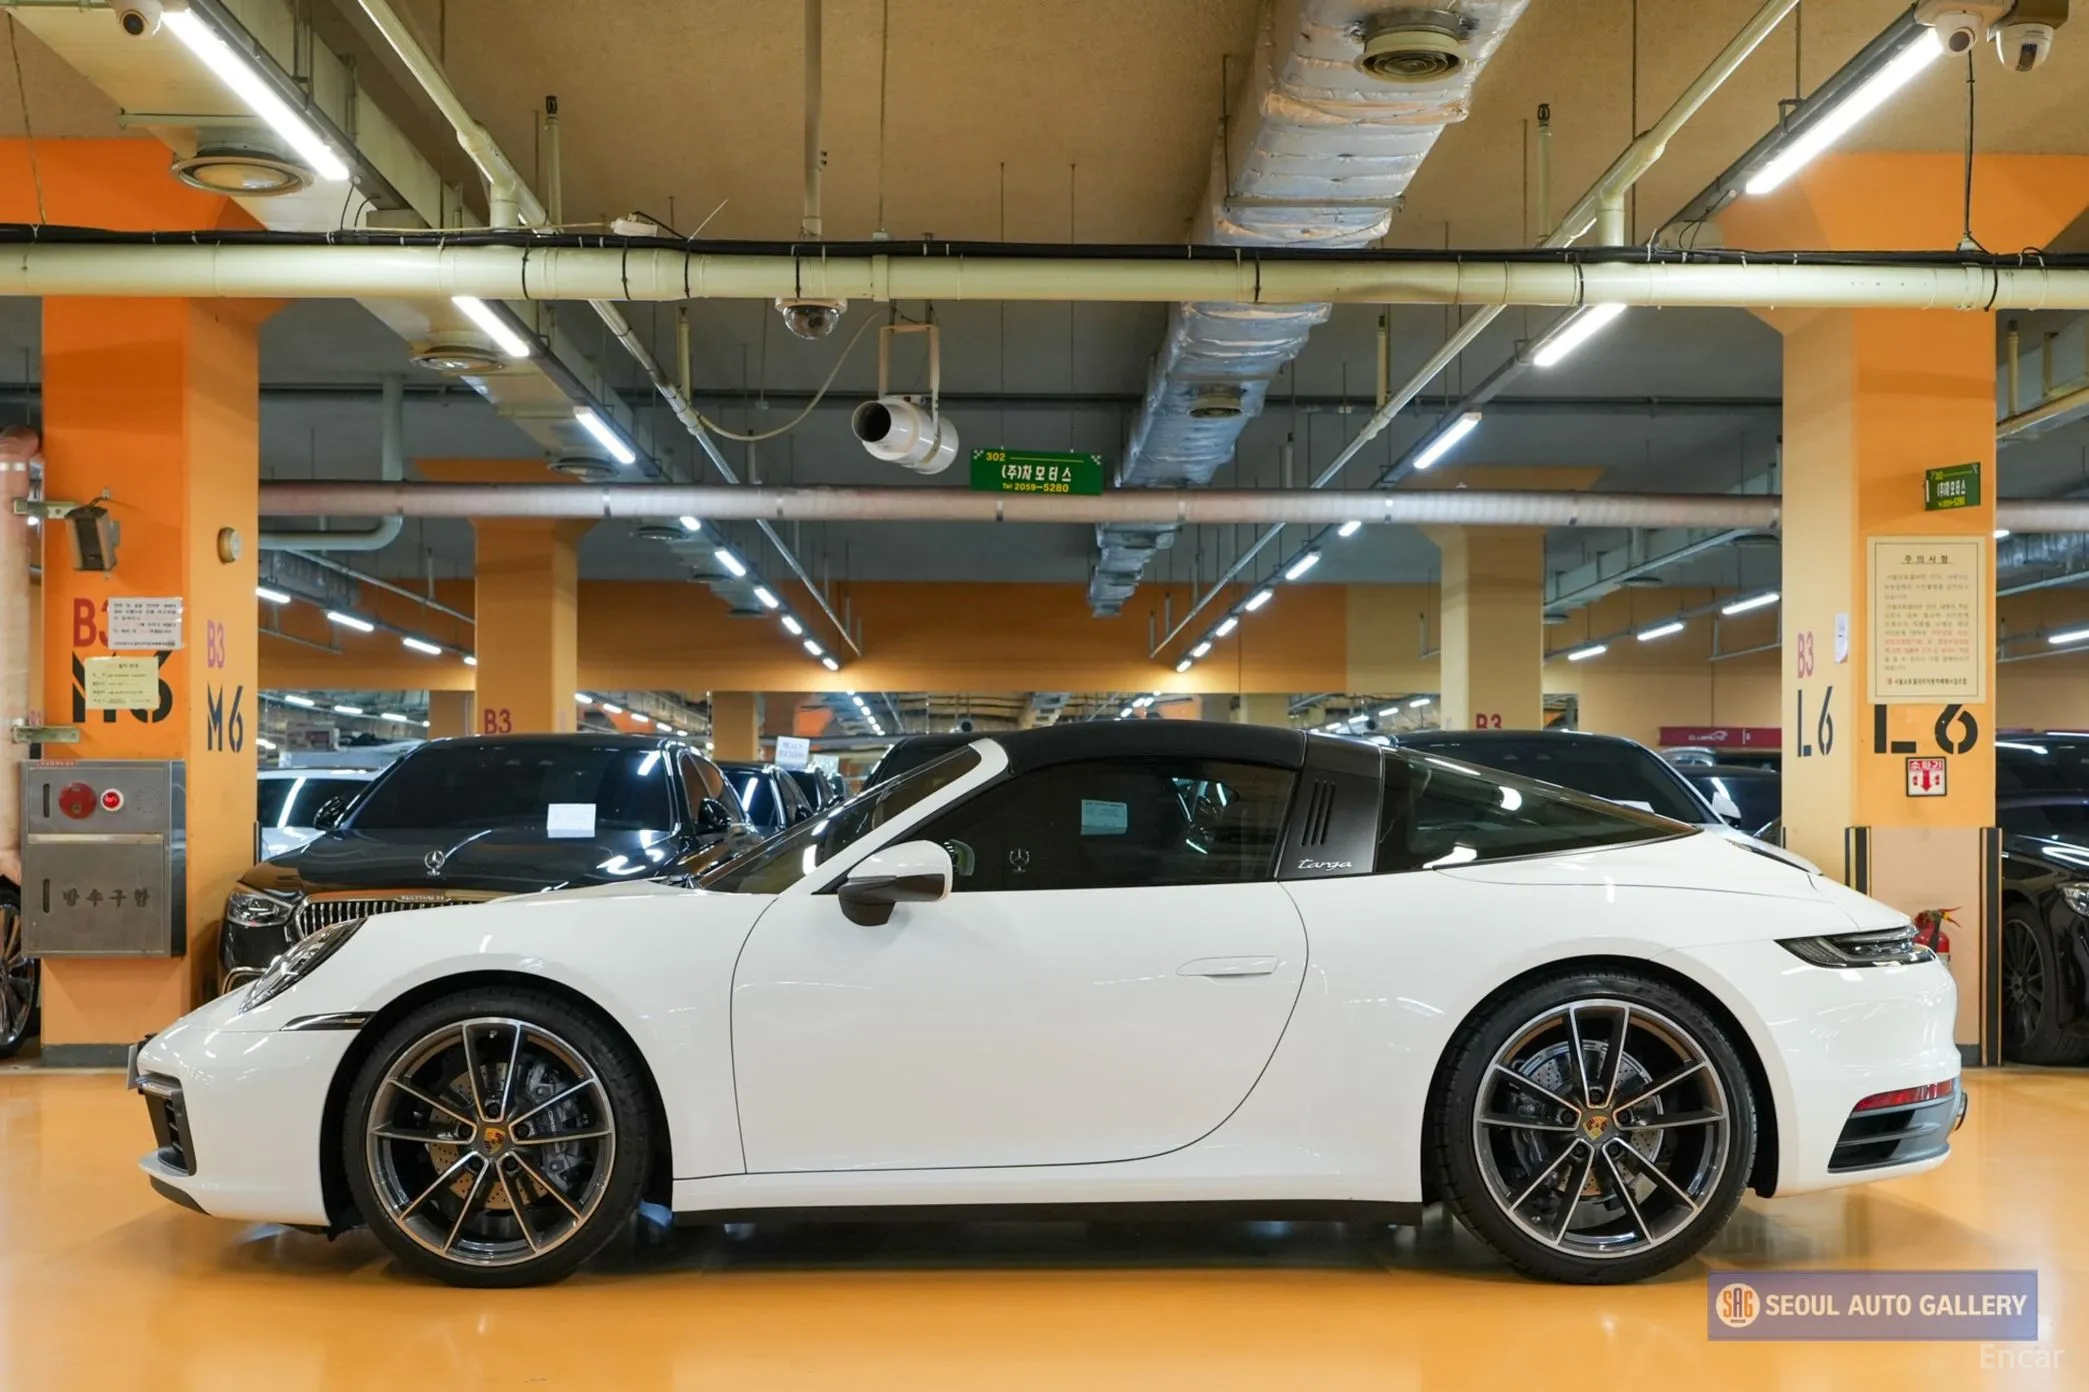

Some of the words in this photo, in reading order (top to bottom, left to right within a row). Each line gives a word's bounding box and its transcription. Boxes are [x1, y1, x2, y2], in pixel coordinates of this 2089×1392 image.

[986, 452, 1006, 461] 302
[1014, 483, 1069, 492] 2059-5280
[207, 620, 225, 669] B3
[1797, 632, 1814, 679] B3
[207, 680, 244, 753] M6
[484, 708, 512, 734] B3
[1797, 685, 1833, 758] L6
[1874, 704, 1979, 755] L6
[1297, 858, 1353, 872] targa
